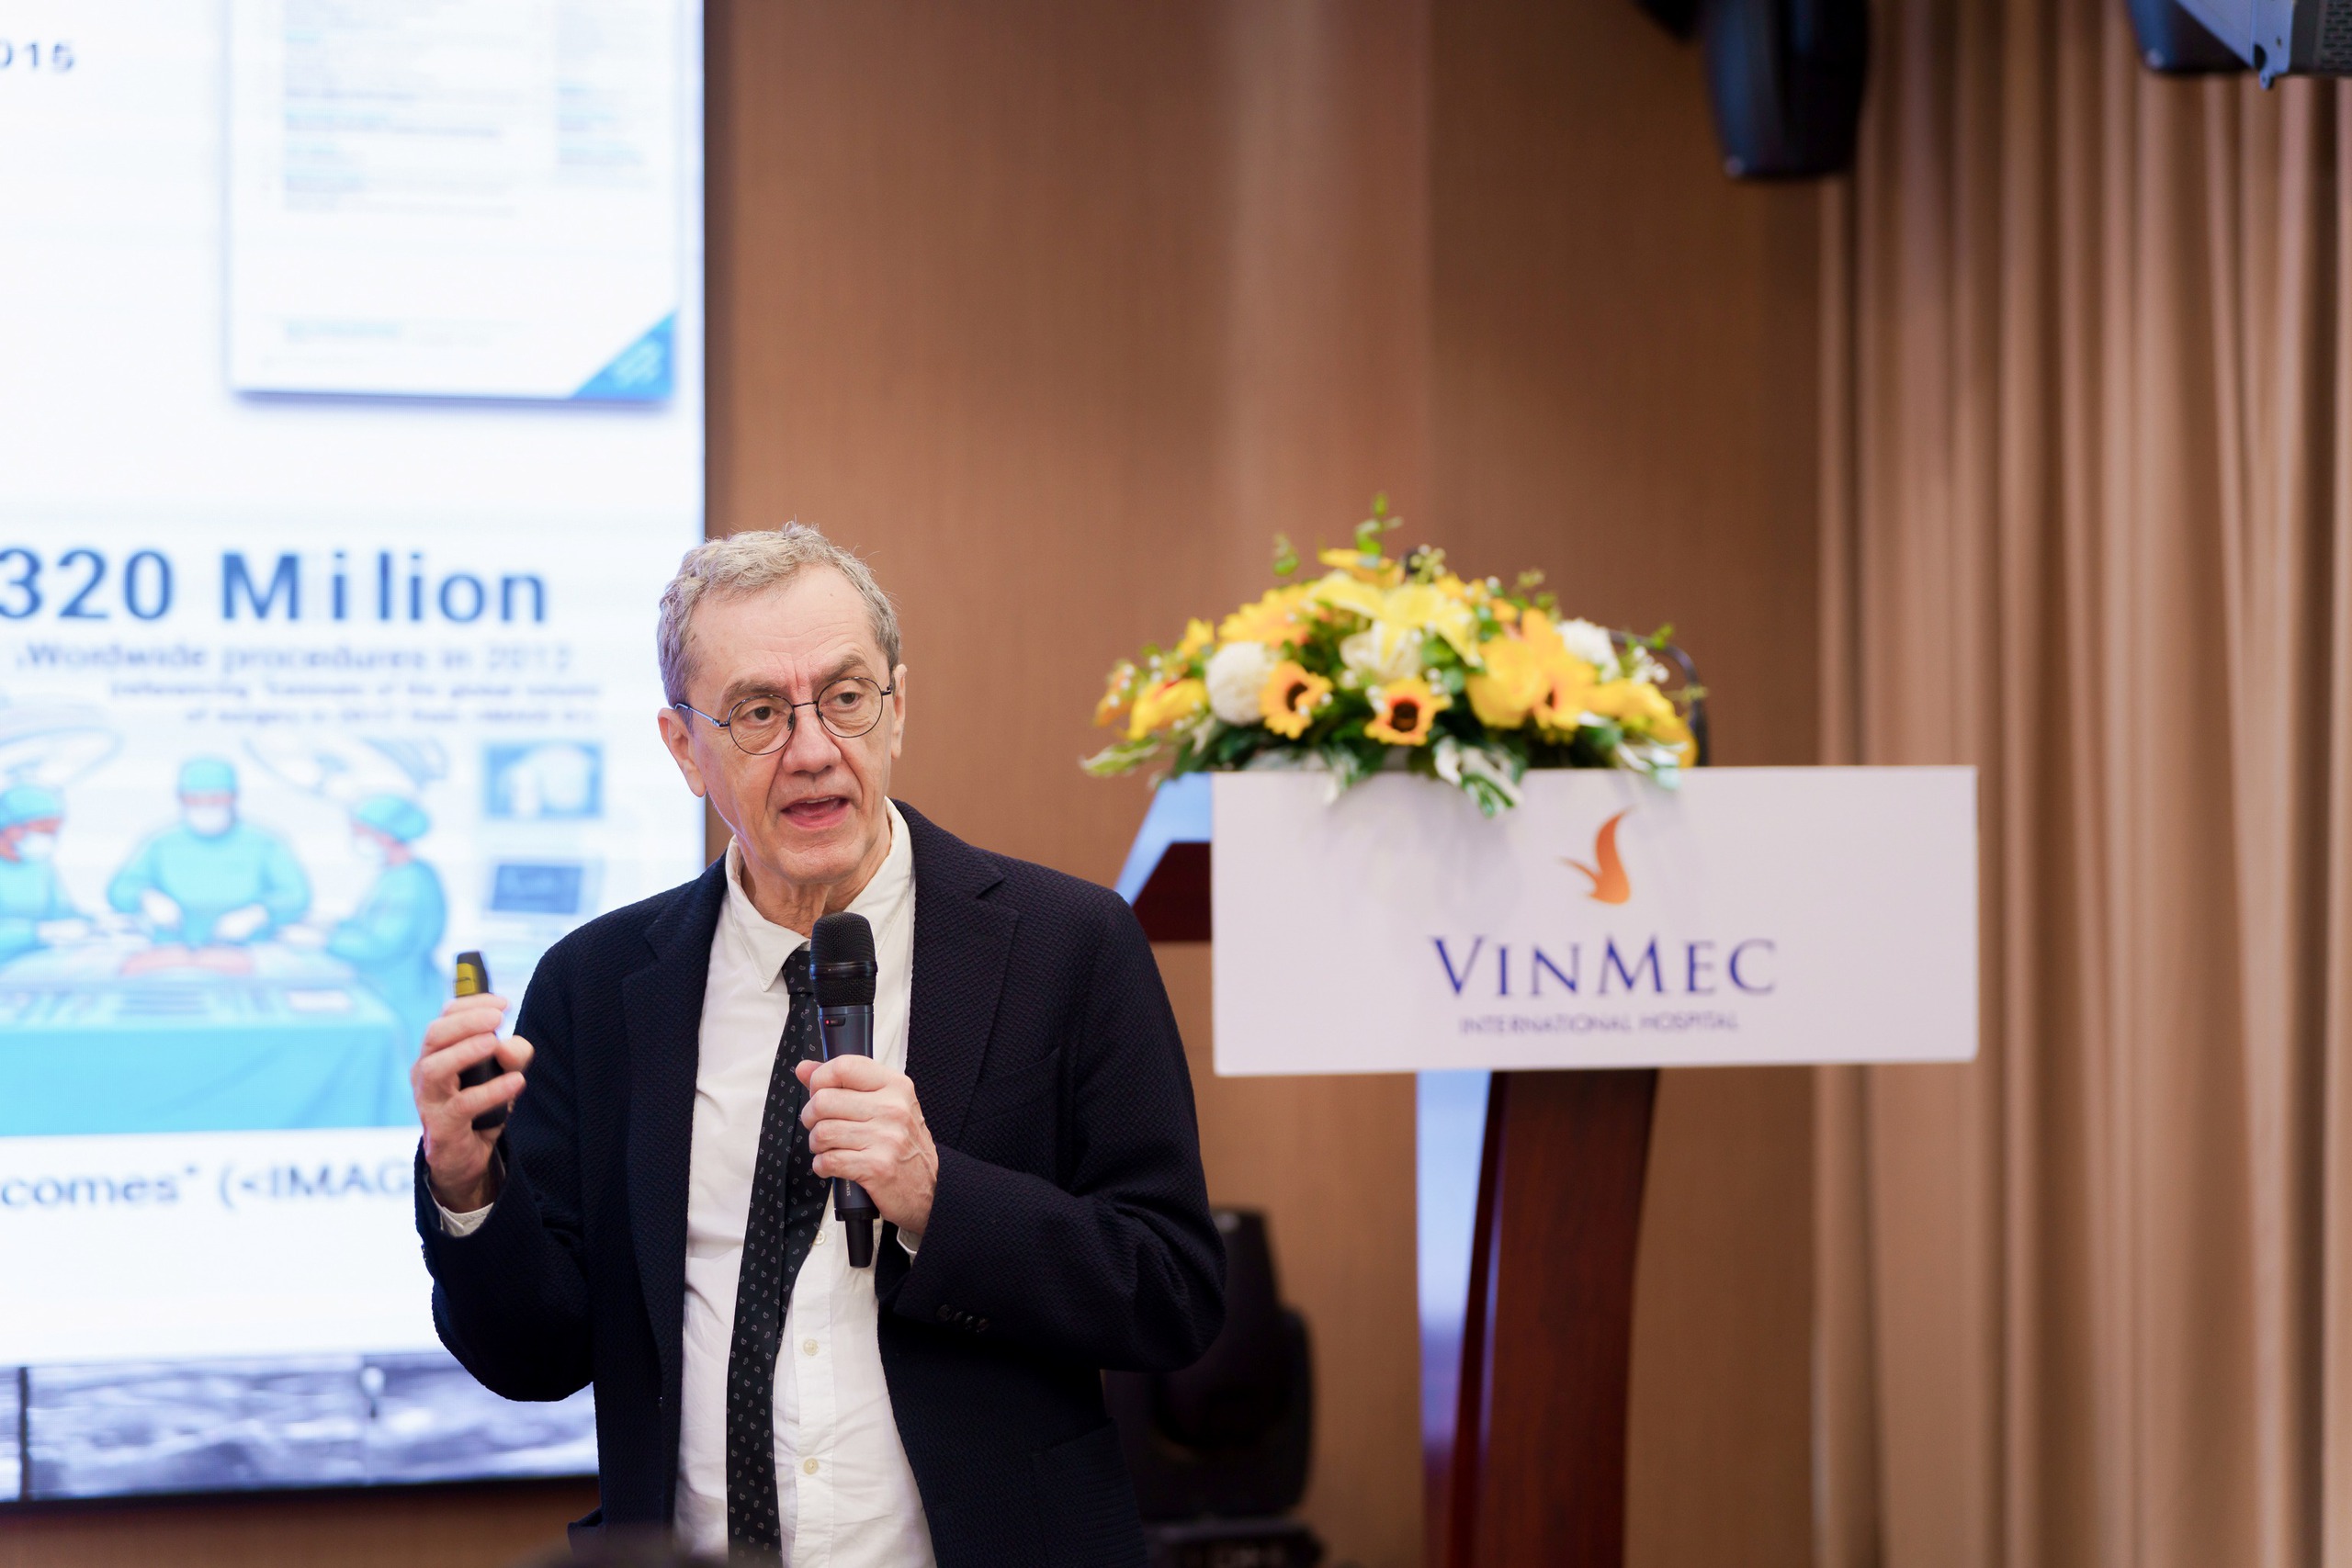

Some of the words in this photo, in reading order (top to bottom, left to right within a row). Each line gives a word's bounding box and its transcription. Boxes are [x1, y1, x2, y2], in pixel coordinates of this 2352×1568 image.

[0, 547, 175, 622] 320
[1459, 1011, 1634, 1035] INTERNATIONAL
[1638, 1008, 1740, 1034] HOSPITAL
